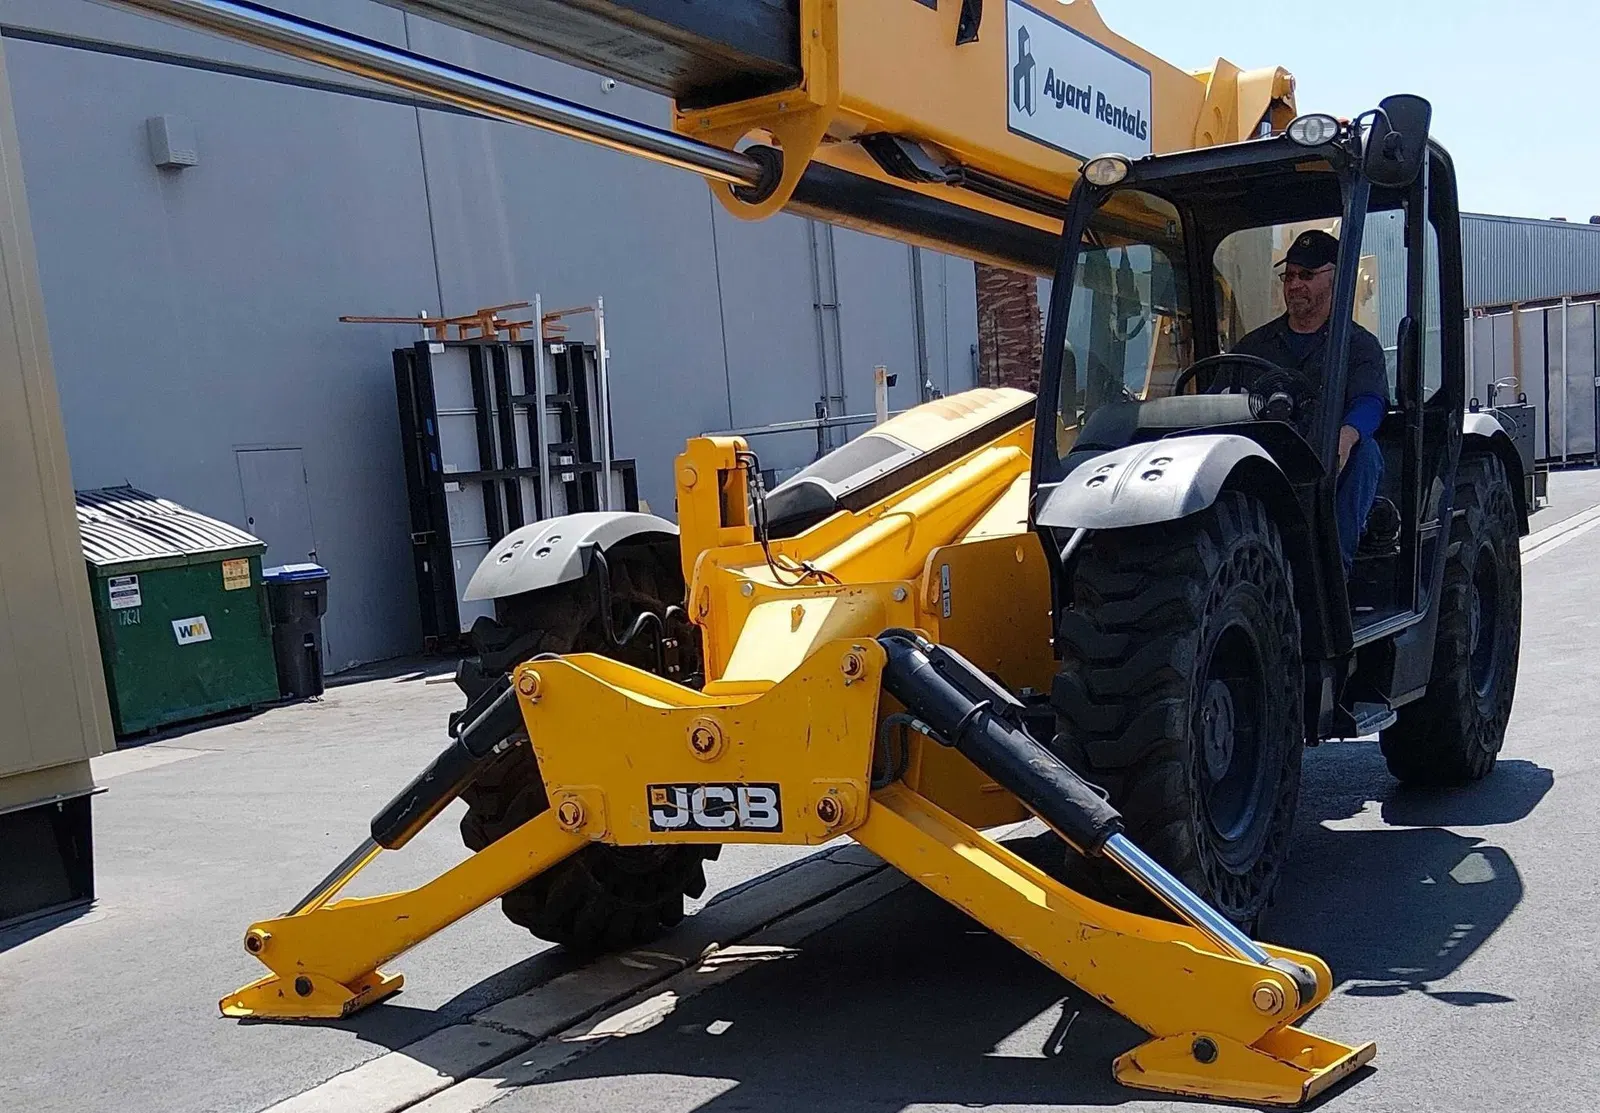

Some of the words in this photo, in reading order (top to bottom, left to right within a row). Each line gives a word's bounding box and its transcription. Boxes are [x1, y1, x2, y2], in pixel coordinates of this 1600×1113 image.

[1043, 67, 1092, 115] Ayard
[1096, 91, 1147, 141] Rentals
[178, 623, 206, 638] WM
[651, 786, 780, 828] JCB
